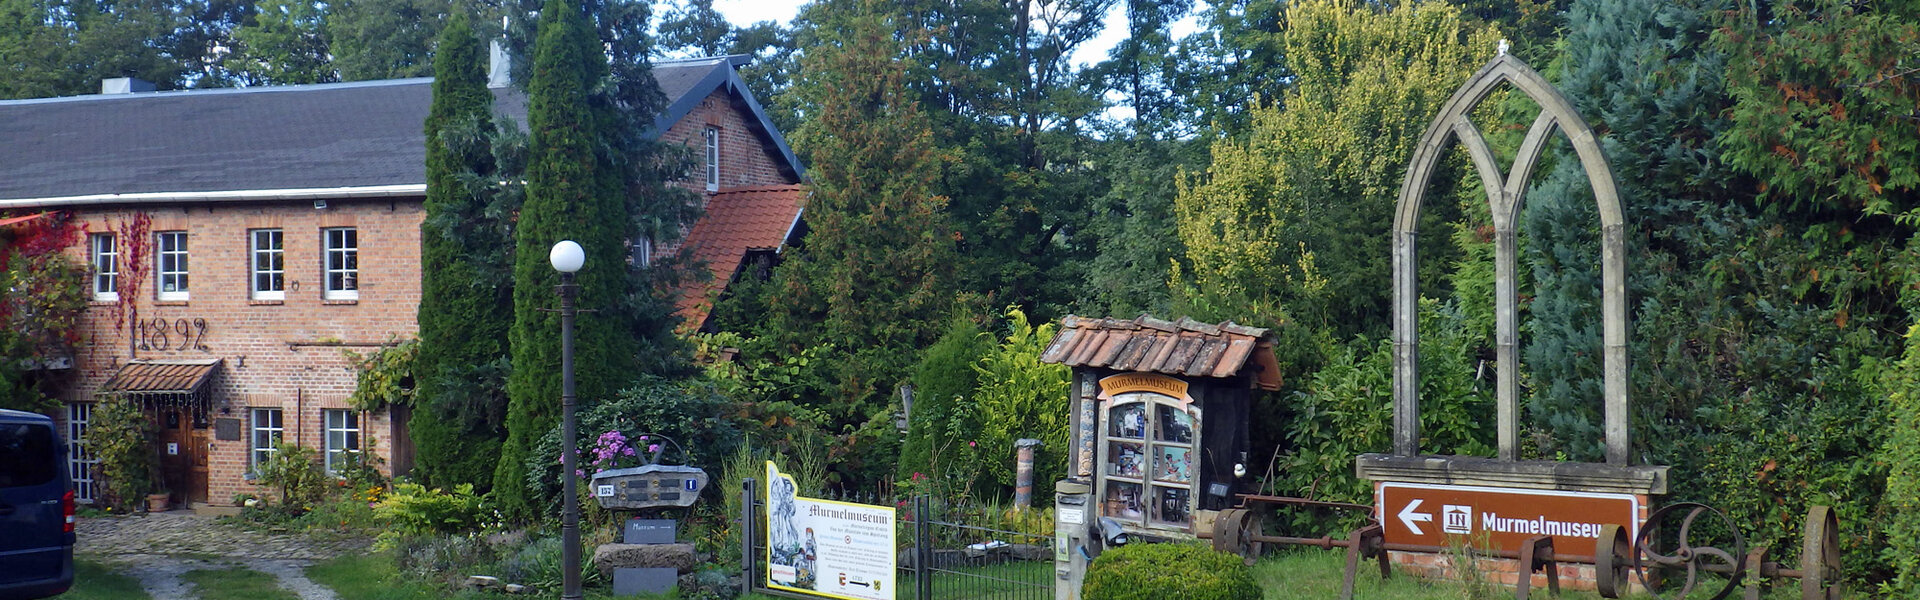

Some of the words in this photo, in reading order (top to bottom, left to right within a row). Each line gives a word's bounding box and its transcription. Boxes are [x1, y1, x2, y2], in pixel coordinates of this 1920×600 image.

[138, 317, 208, 350] 1892
[1107, 377, 1183, 395] MURMELMUSEUM
[809, 504, 888, 524] Murmelmuseum
[1482, 511, 1601, 539] Murmelmuseu
